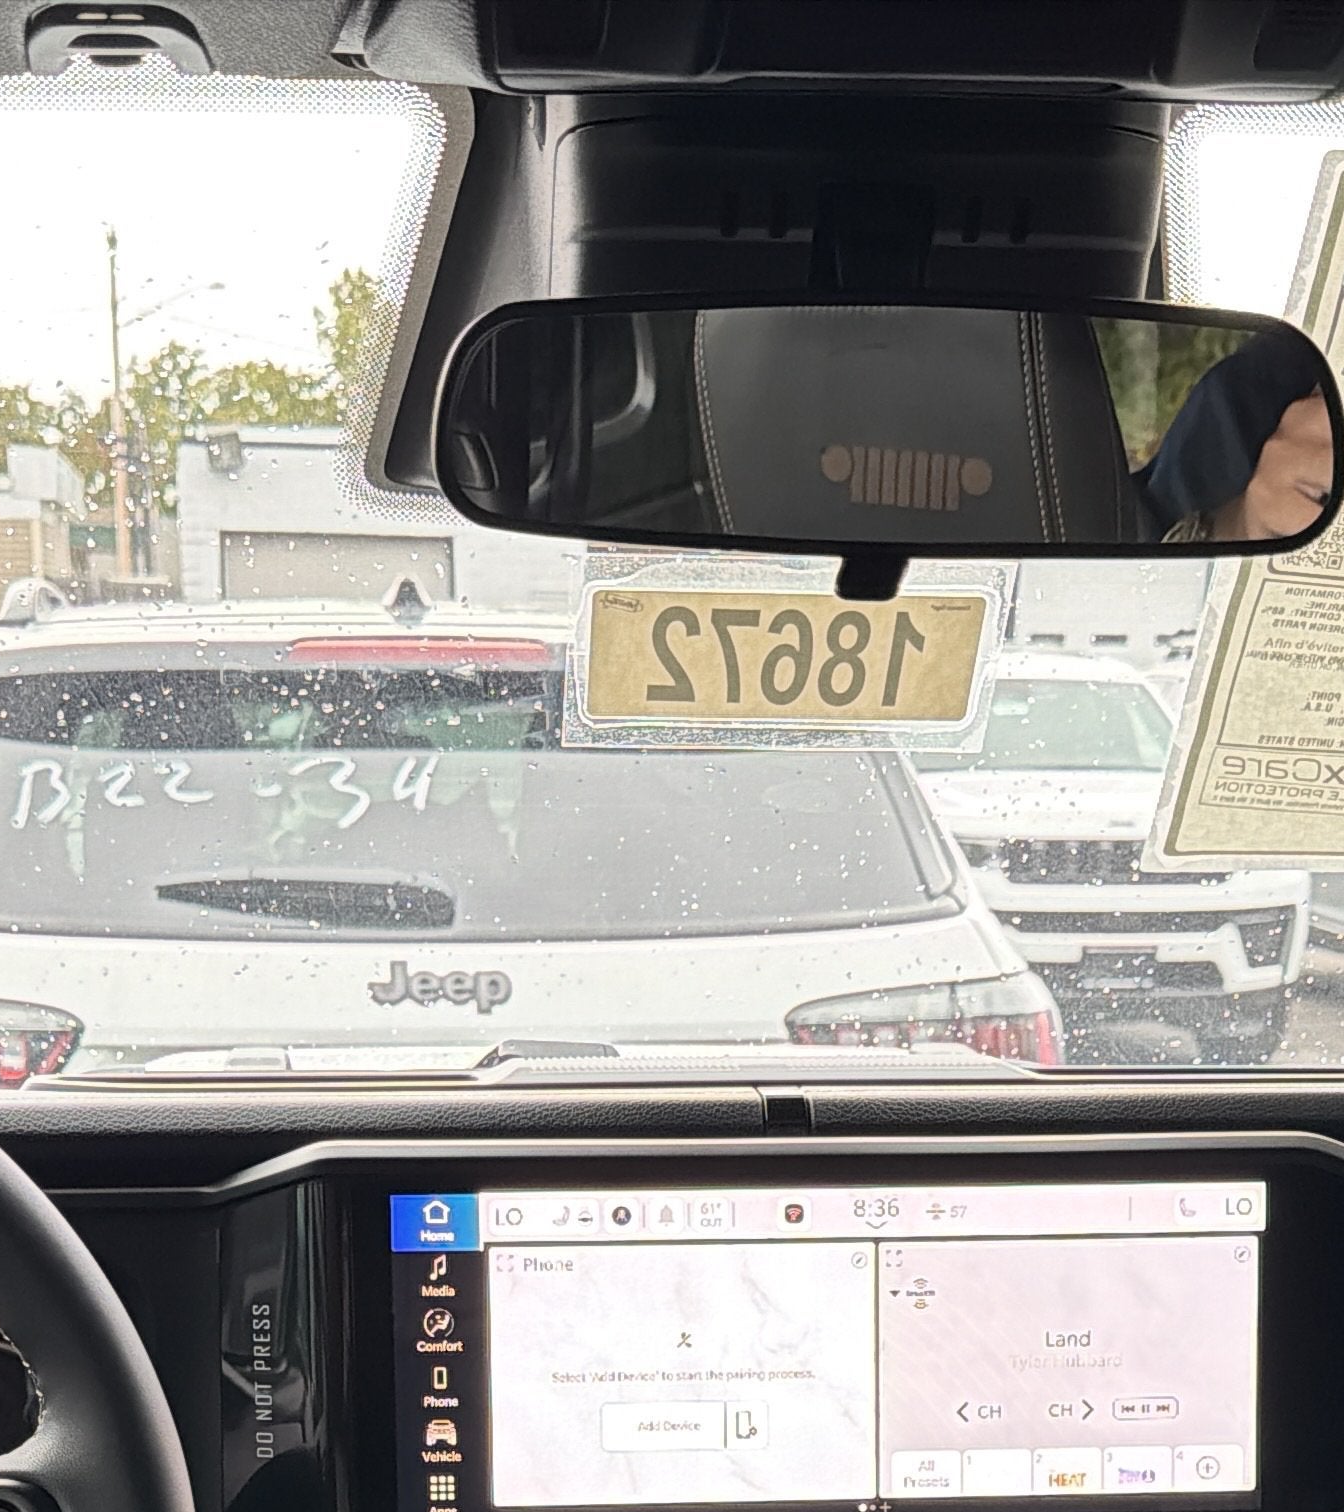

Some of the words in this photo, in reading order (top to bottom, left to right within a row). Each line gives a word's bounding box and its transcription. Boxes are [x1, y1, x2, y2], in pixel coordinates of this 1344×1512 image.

[367, 960, 513, 1015] Jeep
[853, 1197, 901, 1218] 8:36
[1224, 1197, 1253, 1216] LO
[495, 1206, 523, 1226] LO
[420, 1229, 455, 1242] Home
[522, 1257, 575, 1272] Phone
[421, 1285, 456, 1297] Media
[252, 1303, 271, 1371] PRESS
[1044, 1330, 1093, 1348] Land
[416, 1339, 464, 1353] Comfort
[551, 1370, 586, 1384] Select
[662, 1370, 672, 1382] to
[674, 1370, 703, 1383] start
[705, 1369, 723, 1381] the
[725, 1370, 766, 1385] pairing
[768, 1370, 816, 1384] process.
[254, 1381, 273, 1421] NOT
[422, 1395, 460, 1408] Phone
[976, 1404, 1003, 1420] CH
[1047, 1403, 1074, 1418] CH
[256, 1431, 274, 1459] DO
[421, 1450, 463, 1463] Vehicle
[1047, 1472, 1087, 1488] HEAT
